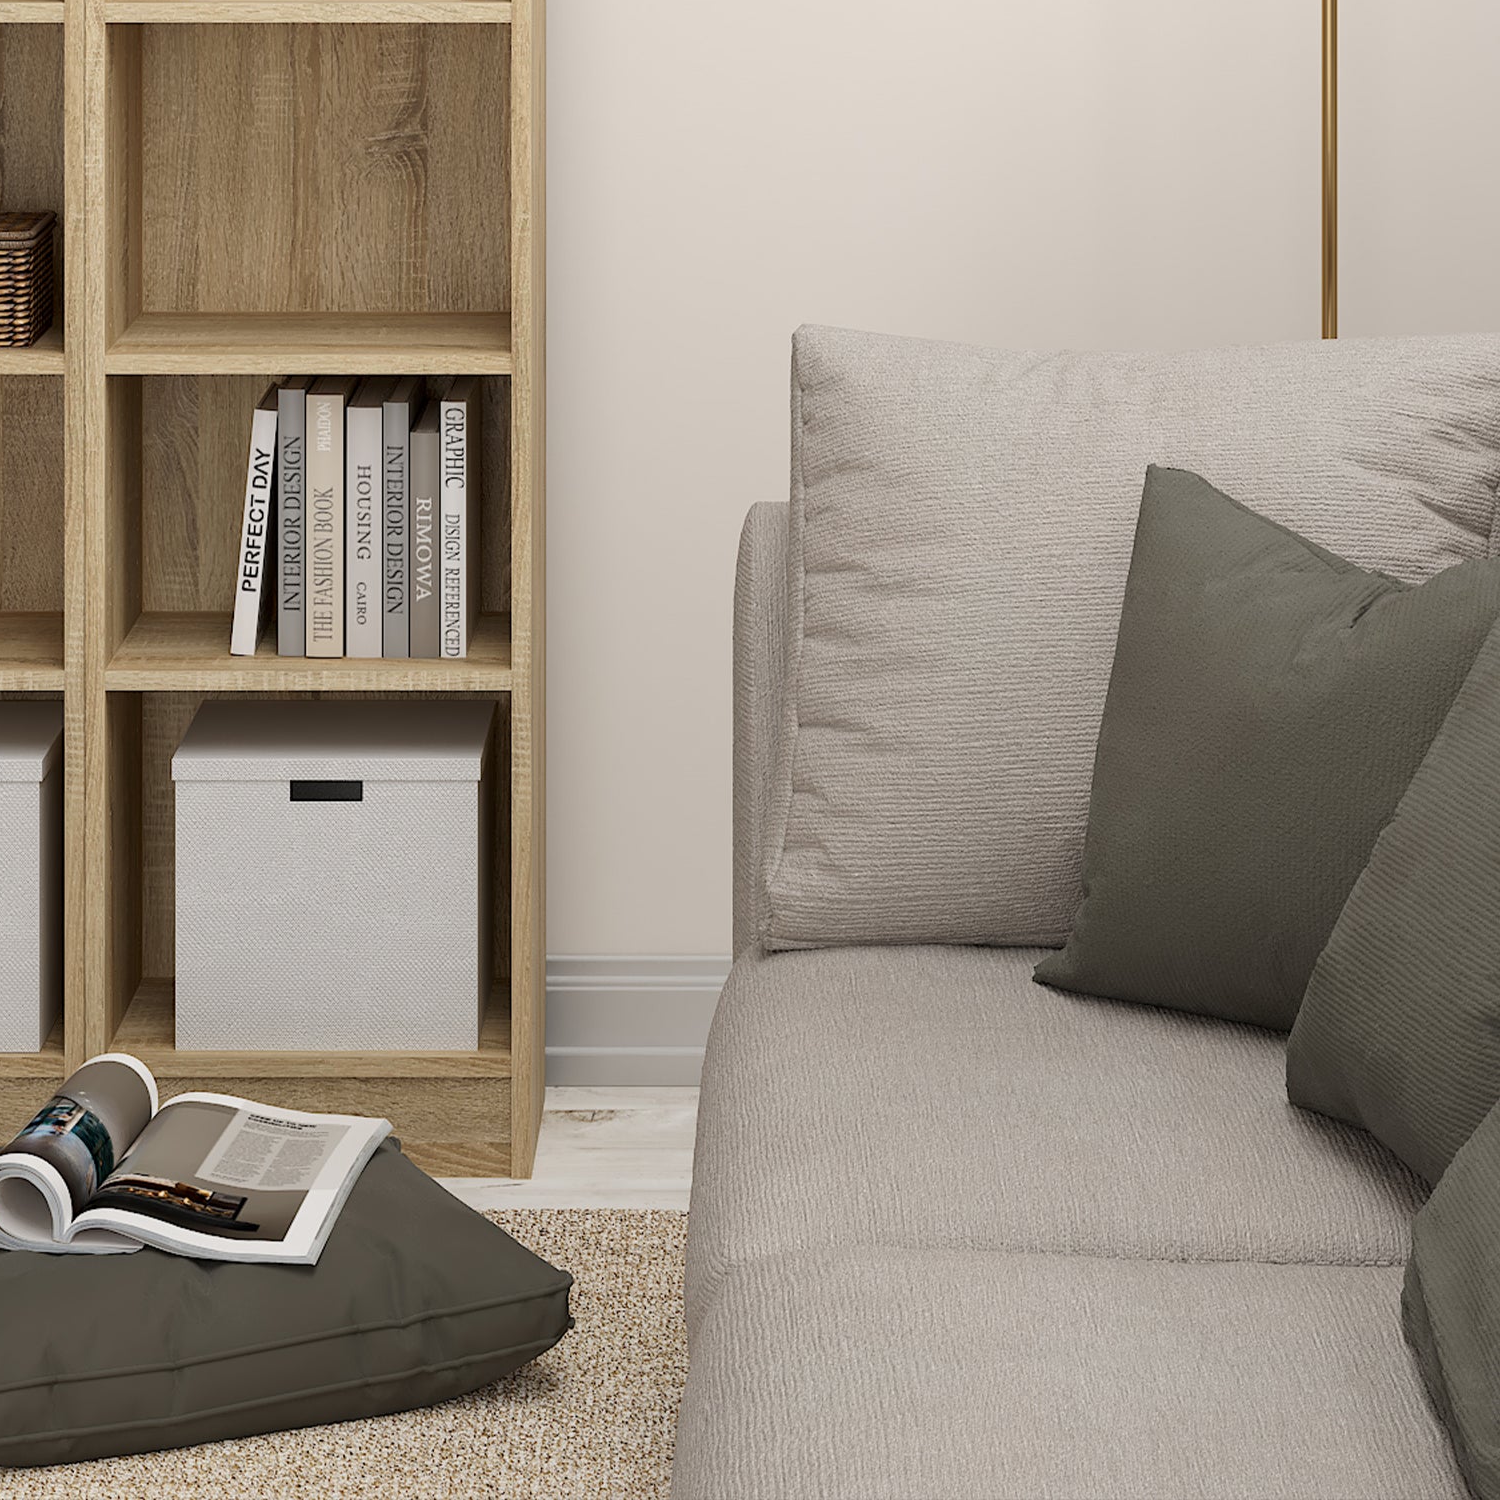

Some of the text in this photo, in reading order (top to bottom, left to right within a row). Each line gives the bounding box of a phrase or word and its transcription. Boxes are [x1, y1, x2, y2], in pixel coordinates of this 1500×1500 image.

[316, 402, 331, 452] PHAIDON
[241, 448, 271, 592] PERFECT DAY
[283, 435, 301, 612] INTERIOR DESIGN
[313, 486, 334, 643] THE FASHION BOOK
[356, 465, 371, 626] HOUSING CAIRO
[386, 445, 404, 615] INTERIOR DESIGN
[415, 496, 432, 601] RIMOWA
[444, 407, 465, 657] GRAPHIC DISIGN REFERENCED
